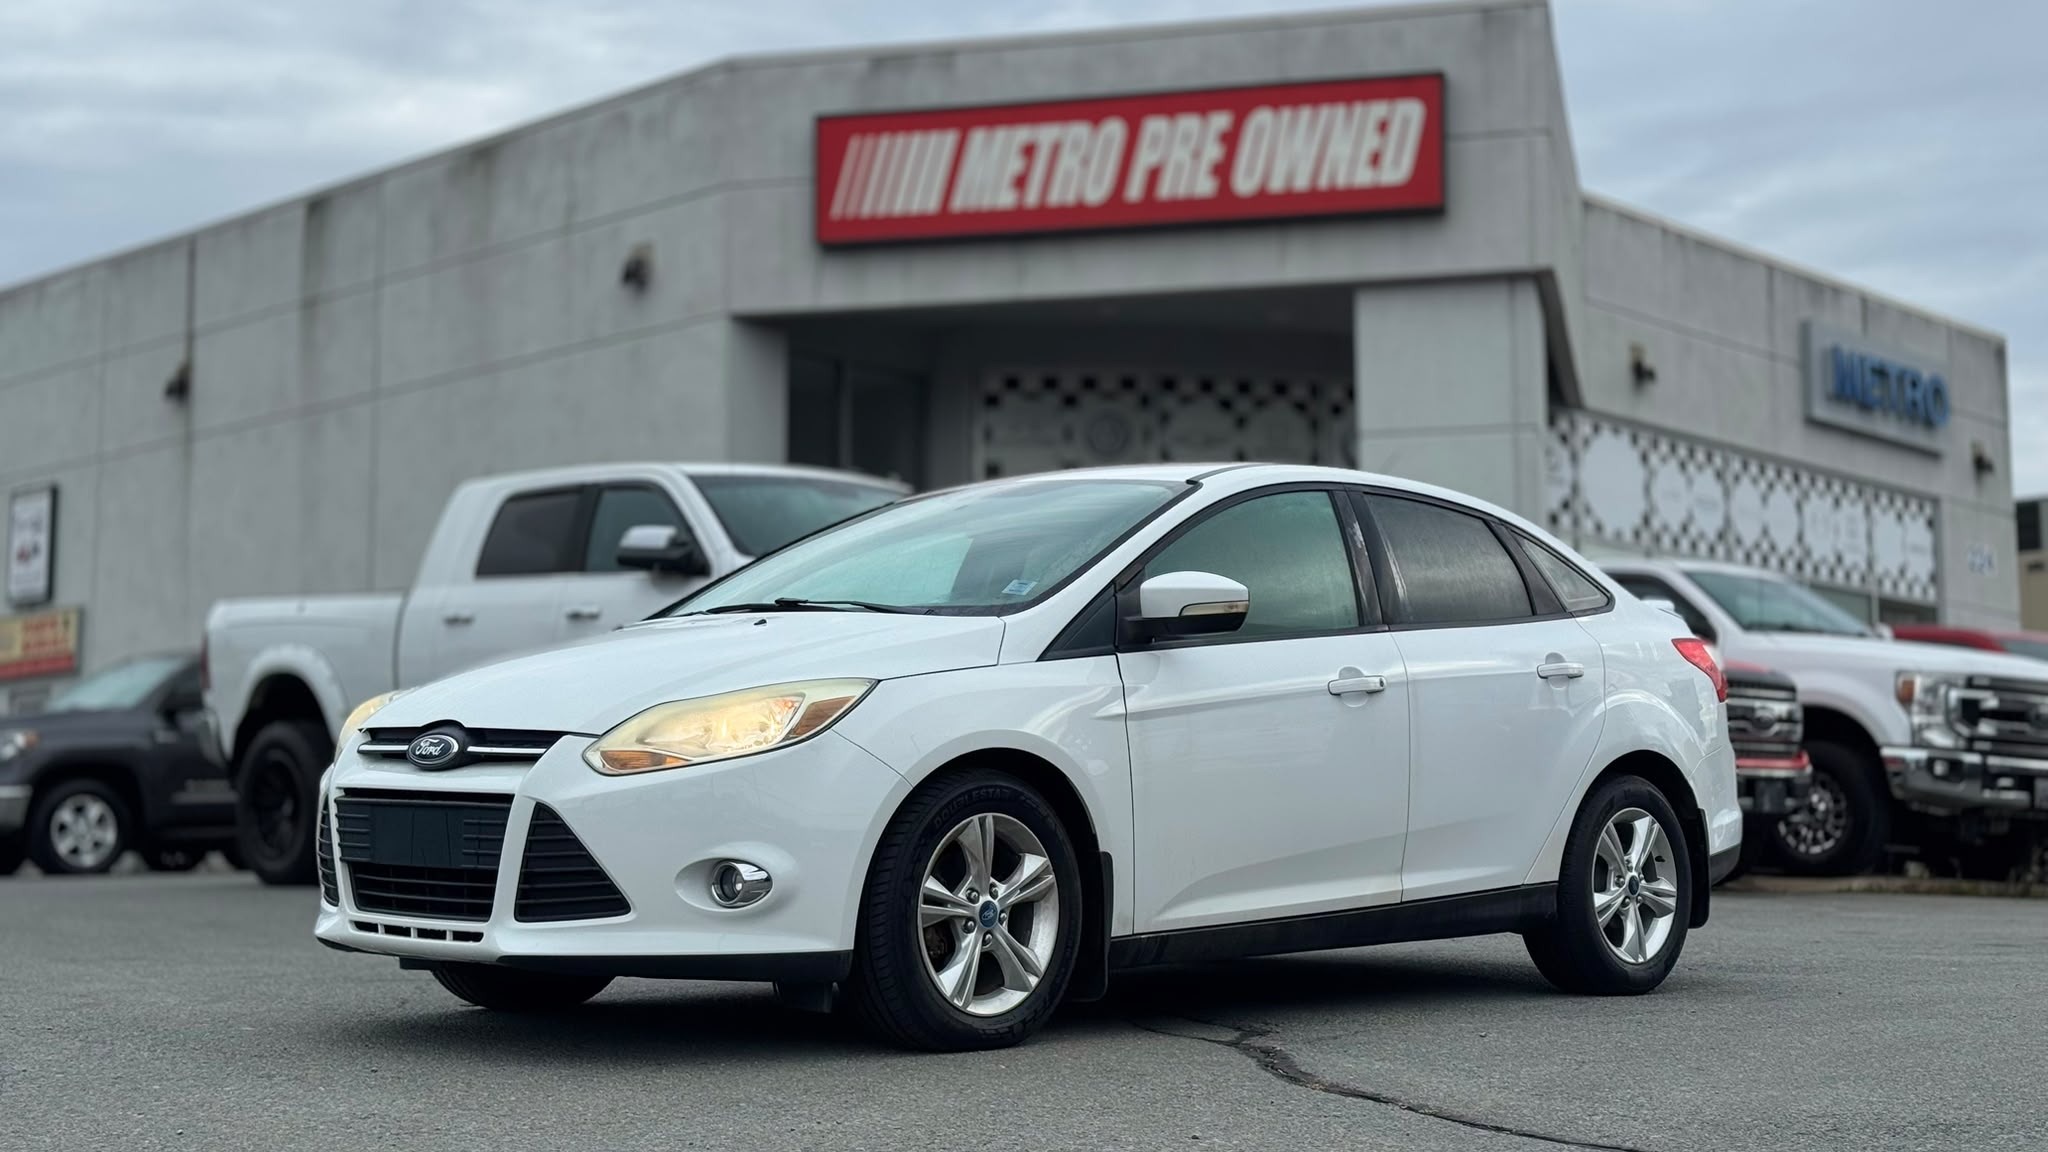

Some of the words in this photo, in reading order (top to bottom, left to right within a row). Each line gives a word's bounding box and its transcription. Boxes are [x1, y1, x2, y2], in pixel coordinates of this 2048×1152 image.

[949, 116, 1127, 213] METRO
[1124, 110, 1235, 203] PRE
[1230, 97, 1427, 198] OWNED
[1831, 344, 1950, 428] METRO
[415, 738, 445, 756] Ford
